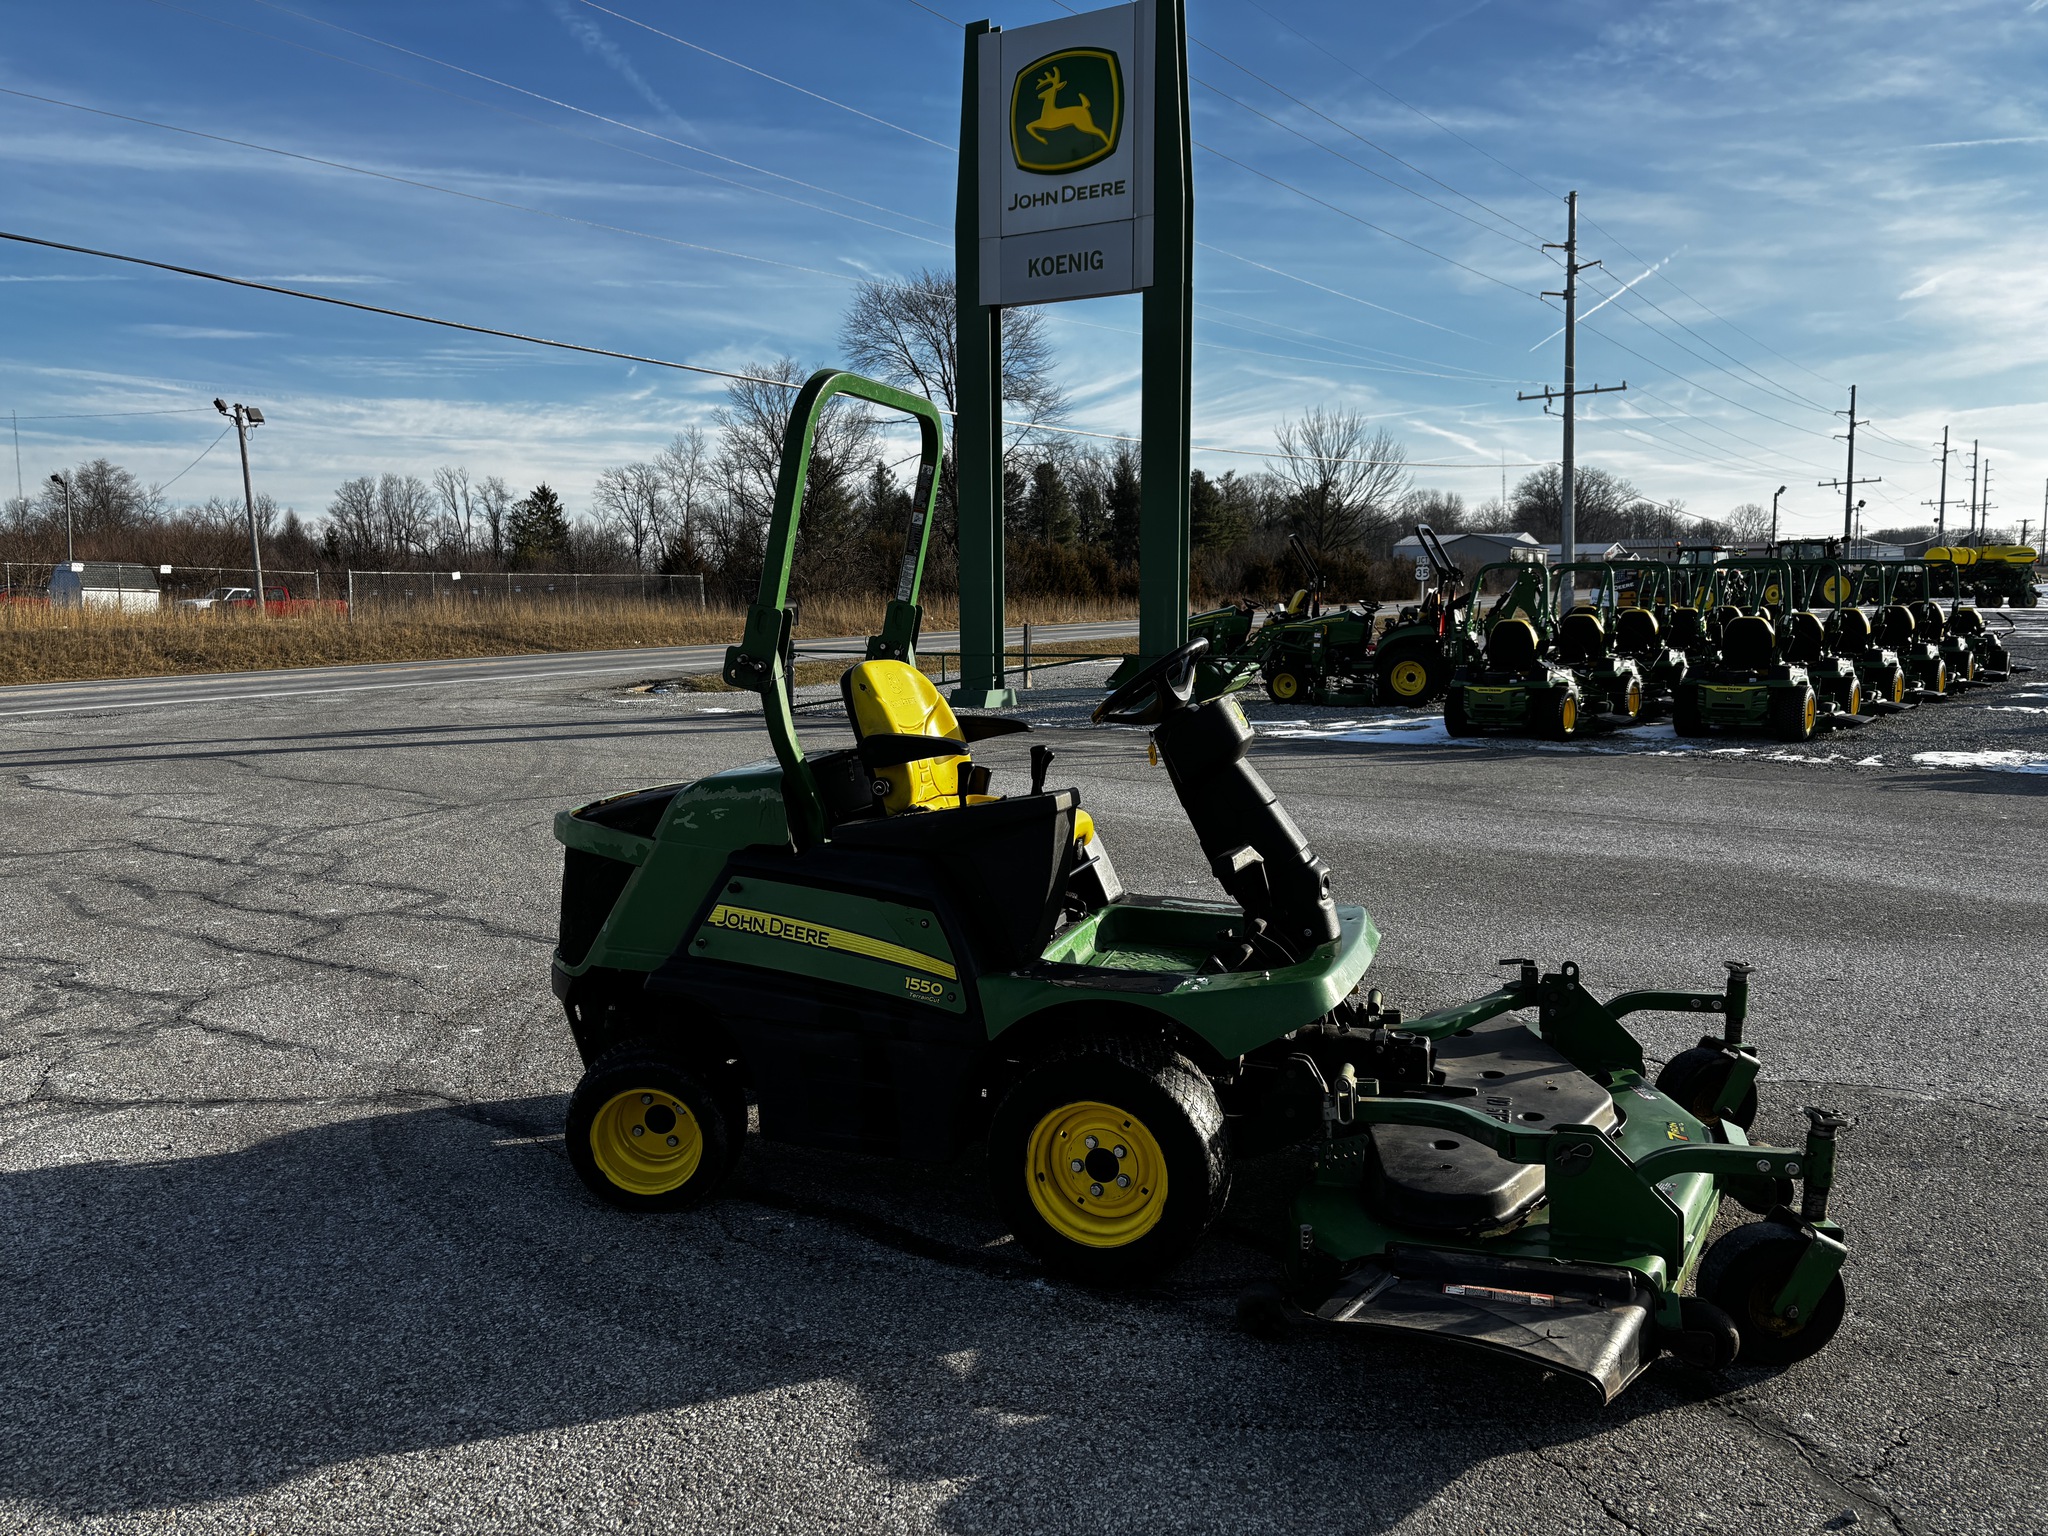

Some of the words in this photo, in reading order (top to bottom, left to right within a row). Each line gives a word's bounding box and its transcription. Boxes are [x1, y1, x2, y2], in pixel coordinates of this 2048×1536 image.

[1008, 190, 1058, 211] JOHN
[1062, 179, 1126, 203] DEERE
[1028, 250, 1104, 278] KOENIG
[1416, 556, 1429, 564] JCT
[1416, 568, 1429, 578] 35
[716, 909, 766, 932] JOHN
[769, 917, 830, 947] DEERE
[904, 976, 944, 996] 1550
